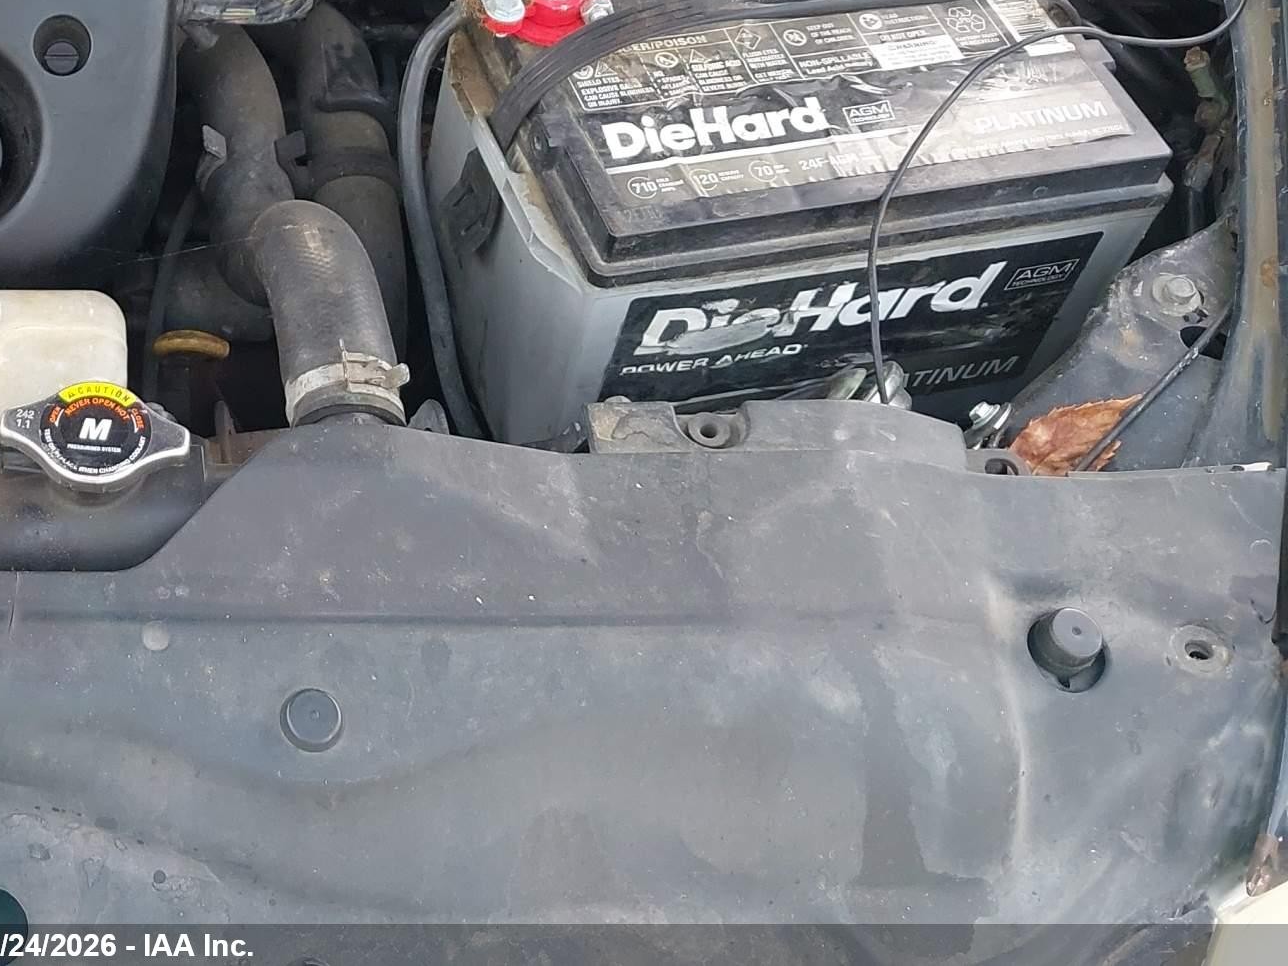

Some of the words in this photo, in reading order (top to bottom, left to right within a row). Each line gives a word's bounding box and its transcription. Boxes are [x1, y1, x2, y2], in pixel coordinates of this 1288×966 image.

[849, 103, 889, 118] AGM
[975, 100, 1109, 134] PLATINUM
[601, 96, 832, 160] DieHard
[693, 172, 719, 185] 120
[754, 165, 773, 177] 70
[632, 180, 657, 193] 710
[1015, 263, 1072, 280] AGM
[634, 262, 1007, 355] DieHard
[715, 345, 802, 367] AHEAD
[77, 386, 130, 403] CAUTION
[16, 409, 35, 418] 242
[49, 405, 62, 423] OPEN
[64, 398, 91, 415] NEVER
[92, 397, 116, 409] OPEN
[114, 405, 131, 421] HOT
[16, 419, 31, 429] 1.1
[131, 408, 145, 429] CLOSE
[79, 417, 112, 441] M
